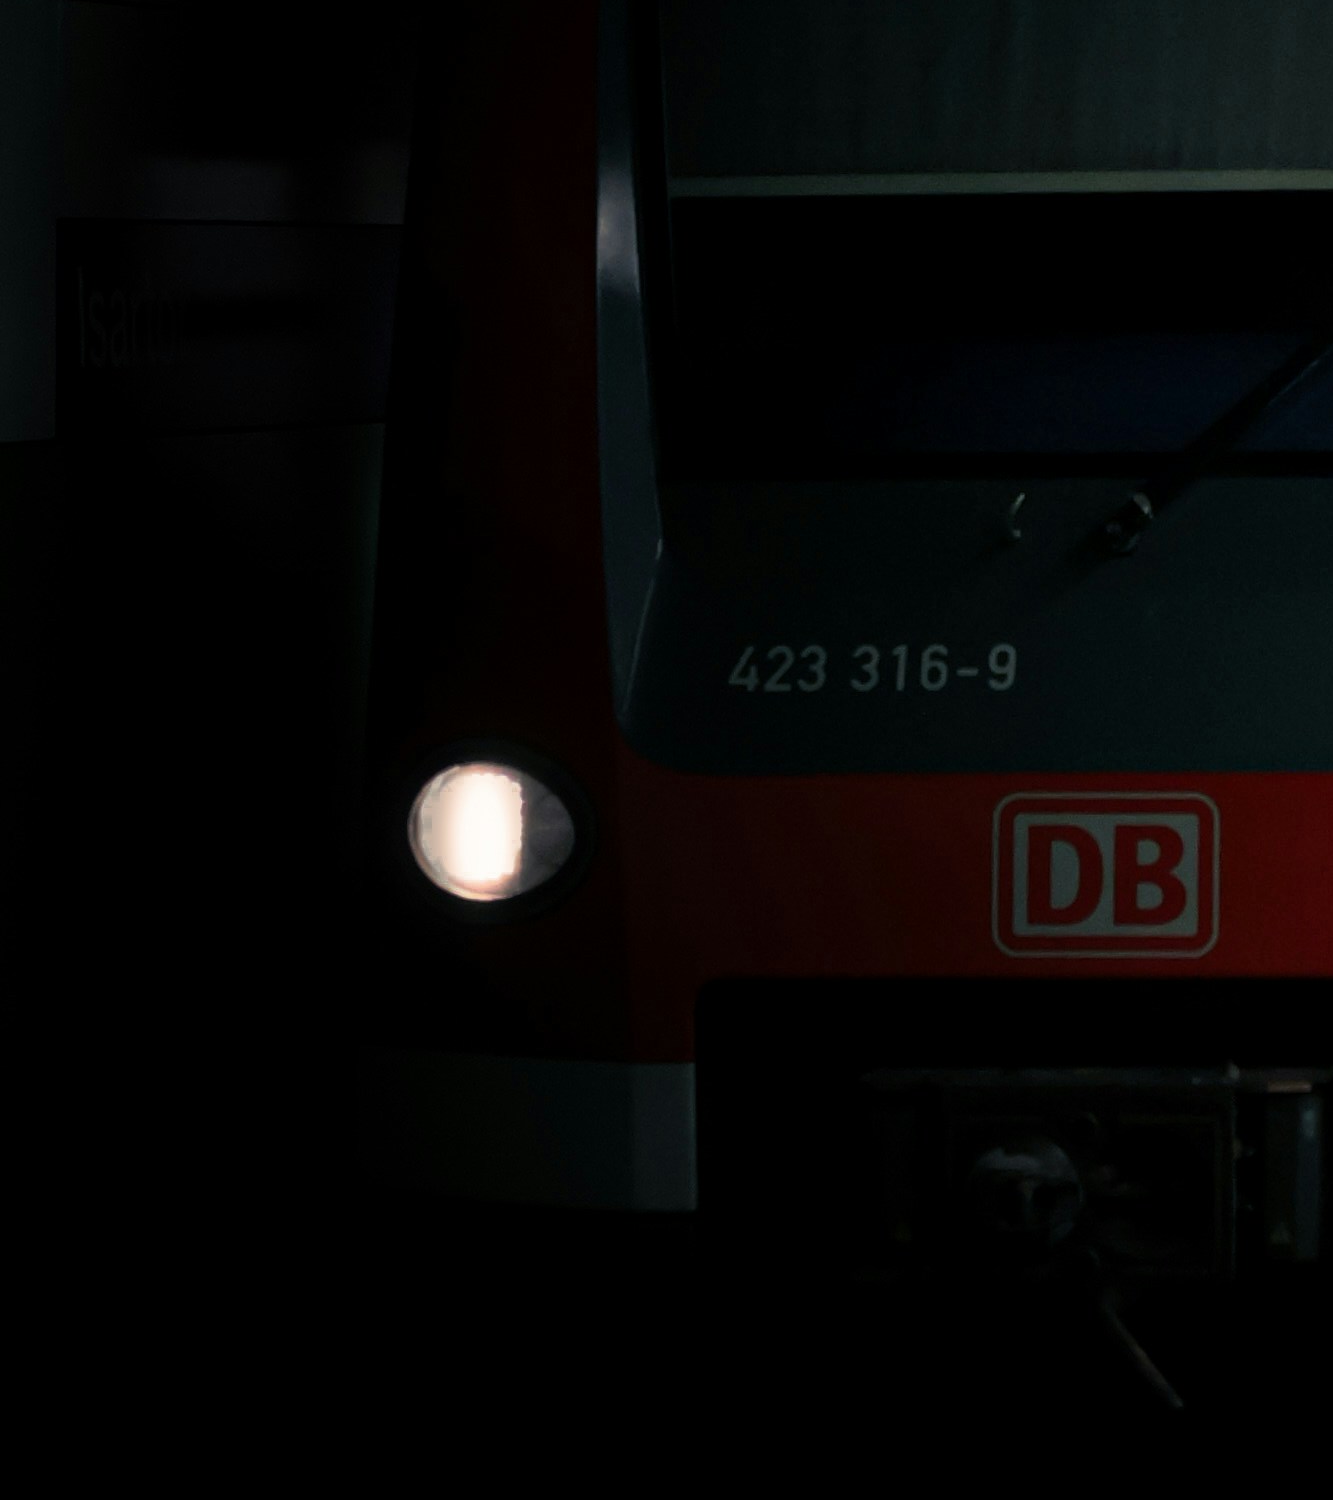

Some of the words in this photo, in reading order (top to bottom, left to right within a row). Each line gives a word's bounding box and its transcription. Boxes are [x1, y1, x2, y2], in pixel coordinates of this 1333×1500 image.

[728, 644, 828, 692] 423
[850, 643, 1018, 692] 316-9
[1023, 820, 1191, 930] DB
